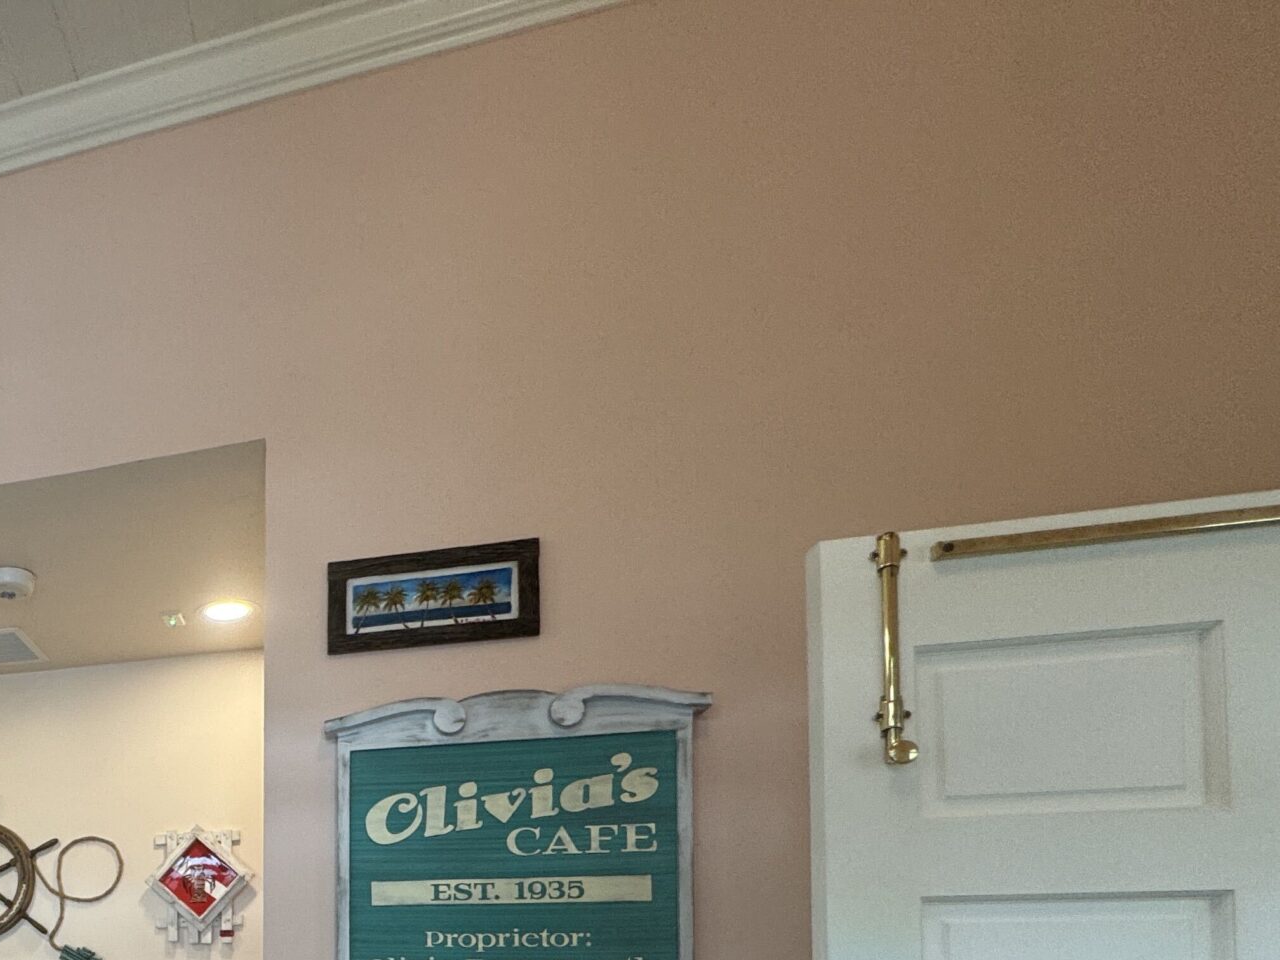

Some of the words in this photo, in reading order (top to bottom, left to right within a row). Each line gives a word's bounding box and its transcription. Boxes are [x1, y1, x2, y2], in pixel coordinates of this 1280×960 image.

[365, 752, 659, 845] Olivia's
[506, 822, 658, 856] CAFE
[430, 882, 500, 902] EST.
[513, 880, 585, 901] 1935
[424, 928, 592, 951] Proprietor:
